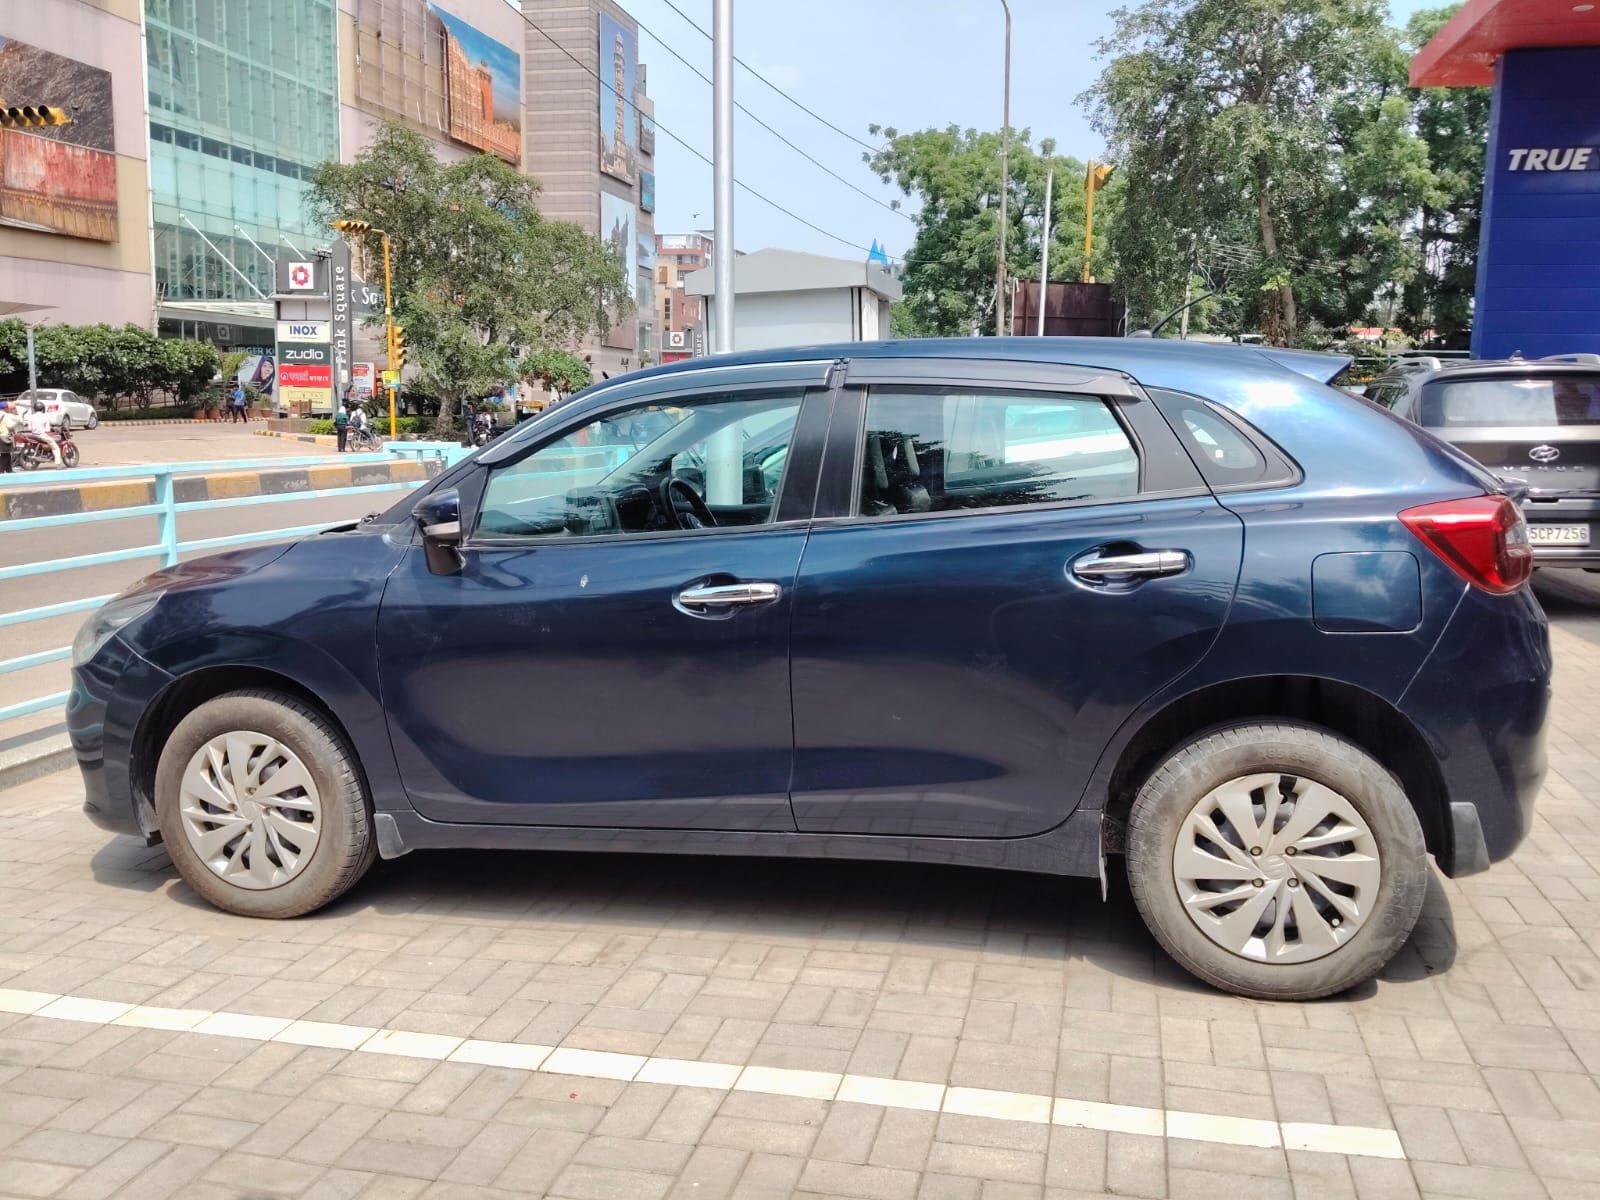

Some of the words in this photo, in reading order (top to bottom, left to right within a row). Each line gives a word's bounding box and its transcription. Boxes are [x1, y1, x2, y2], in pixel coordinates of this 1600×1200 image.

[1508, 148, 1592, 171] TRUE
[334, 266, 347, 321] Square
[289, 325, 317, 335] INOX
[285, 348, 324, 360] zudio
